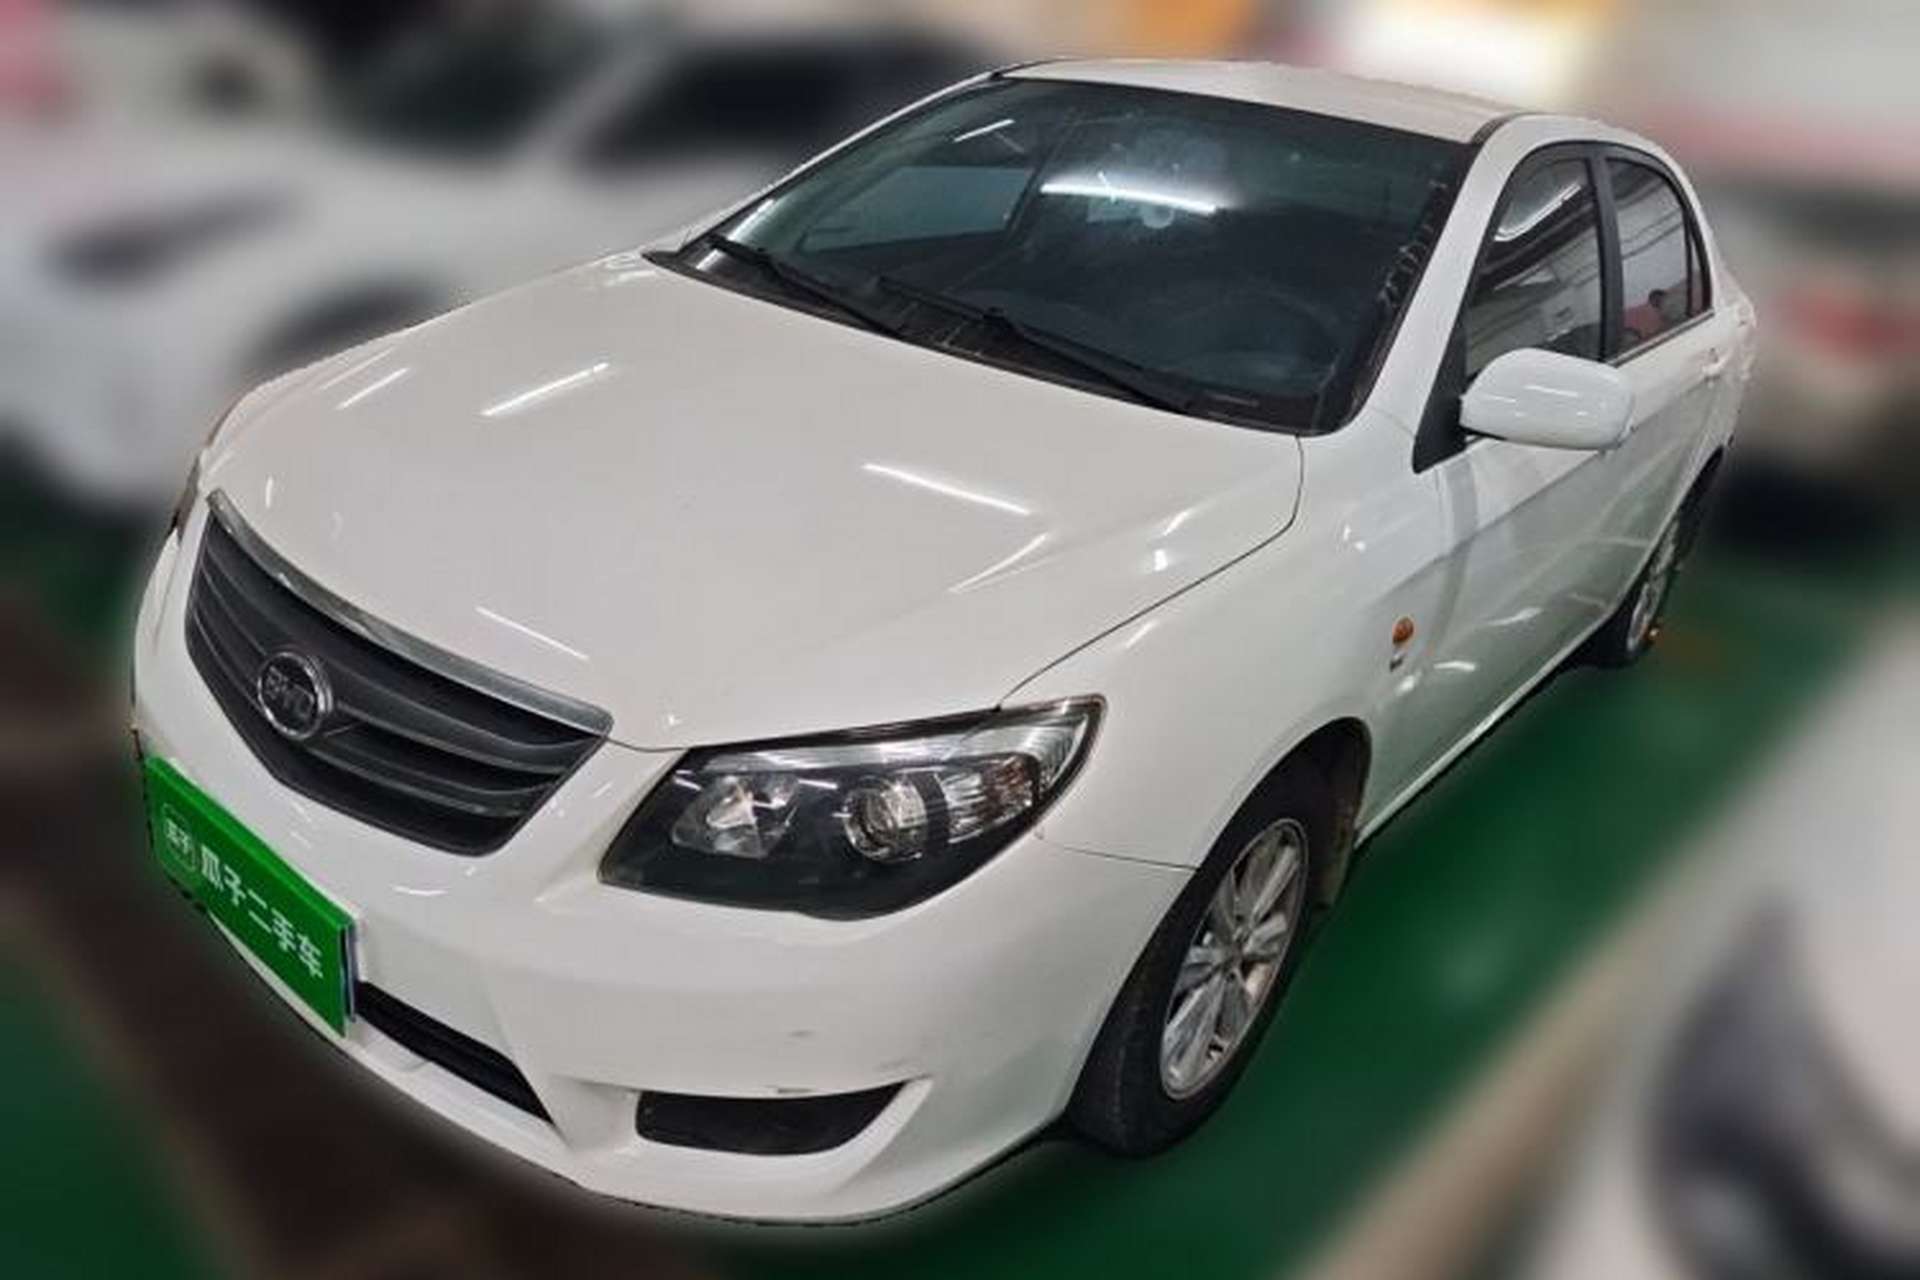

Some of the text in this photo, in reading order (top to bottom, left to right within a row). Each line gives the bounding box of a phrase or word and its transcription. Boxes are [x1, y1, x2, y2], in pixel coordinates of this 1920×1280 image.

[201, 843, 324, 979] 瓜子二手车
